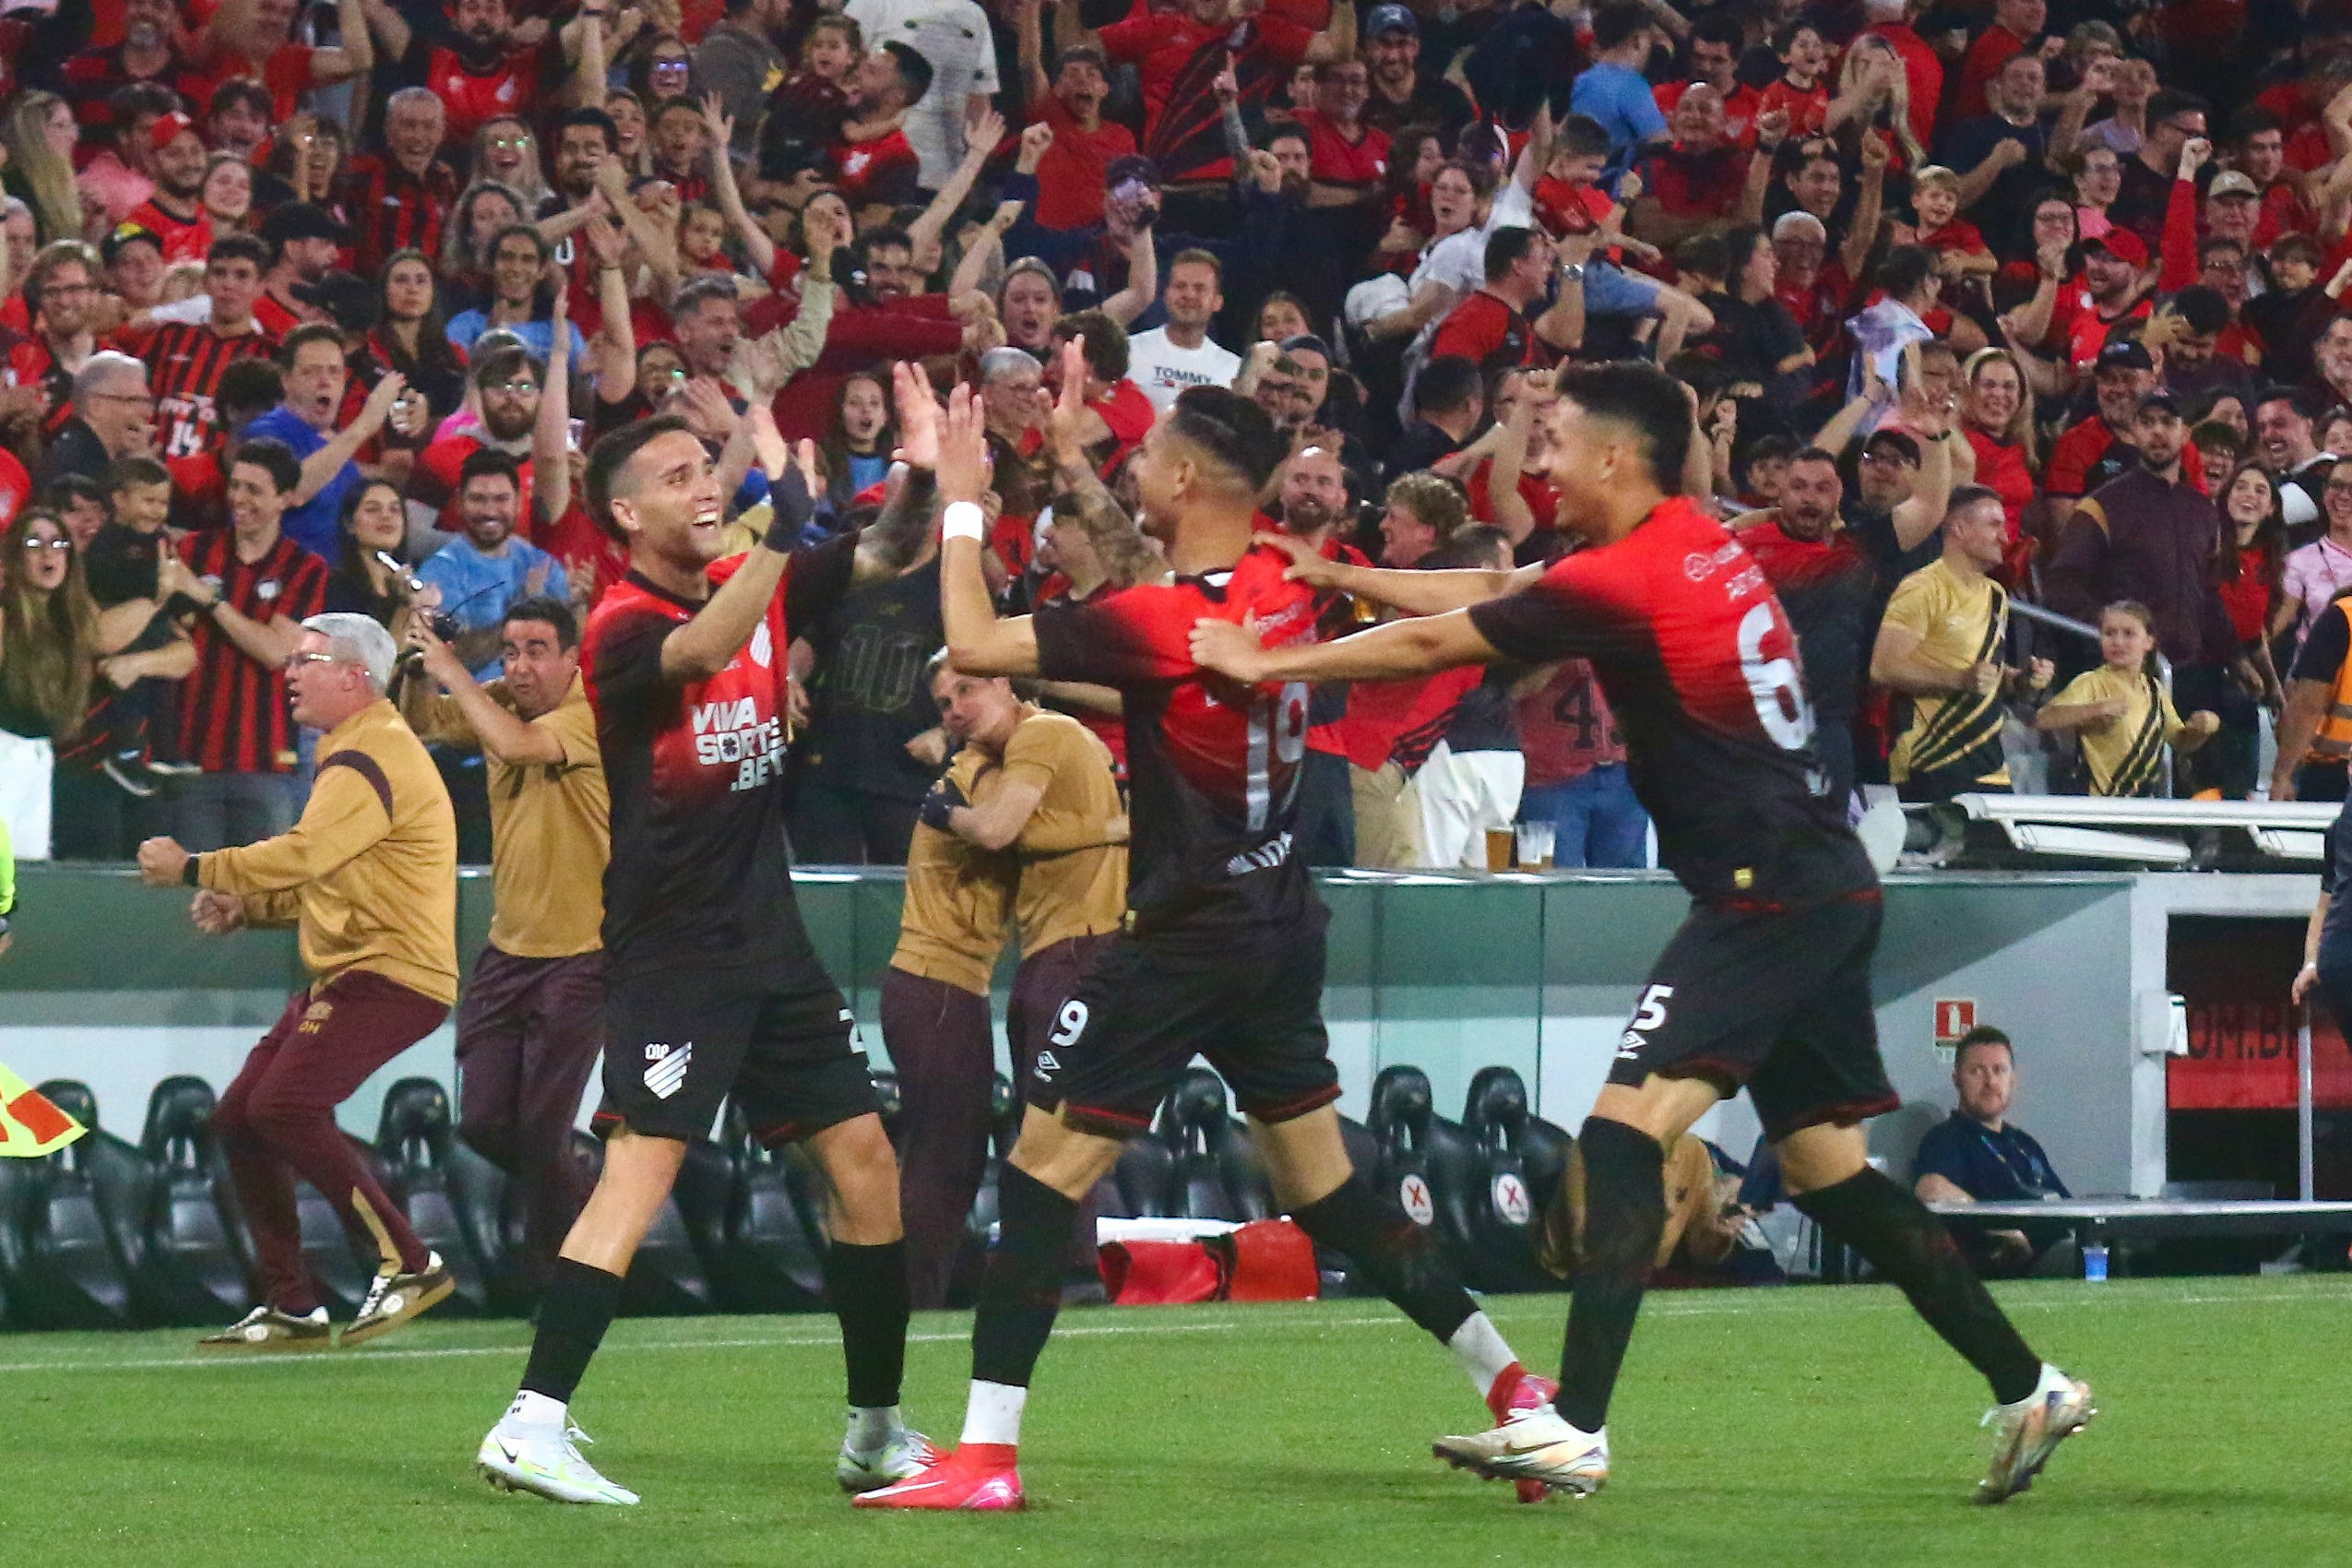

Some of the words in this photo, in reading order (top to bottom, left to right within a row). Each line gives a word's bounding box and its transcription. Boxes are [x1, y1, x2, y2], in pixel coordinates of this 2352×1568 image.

[1155, 366, 1212, 385] TOMMY
[692, 695, 757, 735] VIVA
[731, 744, 788, 792] .BET
[1049, 997, 1088, 1047] 9
[1630, 984, 1674, 1030] 5
